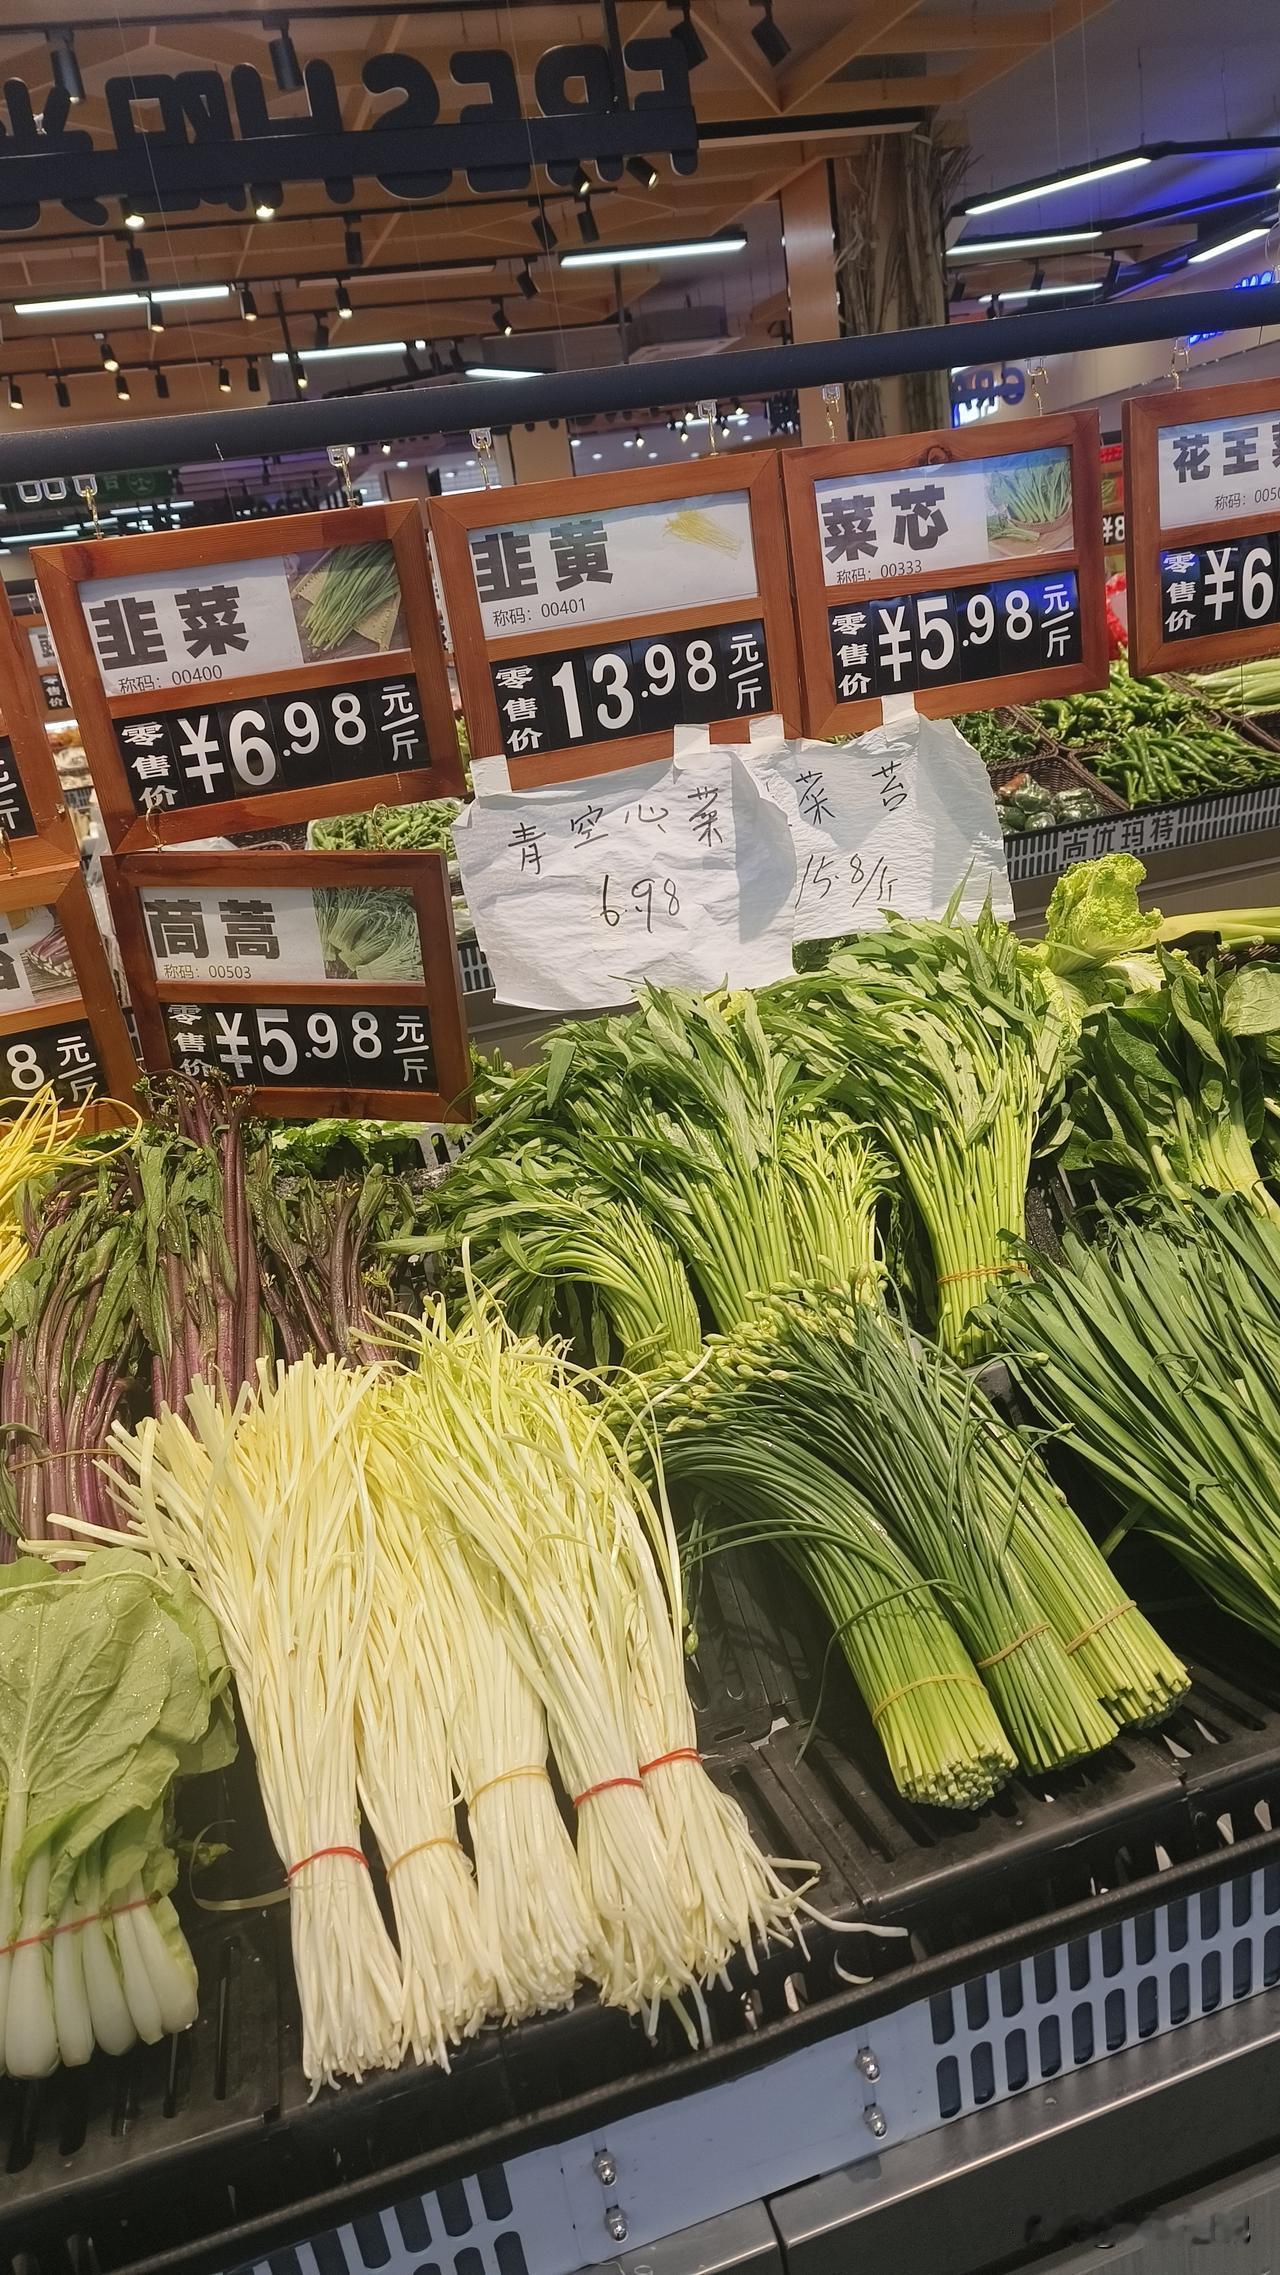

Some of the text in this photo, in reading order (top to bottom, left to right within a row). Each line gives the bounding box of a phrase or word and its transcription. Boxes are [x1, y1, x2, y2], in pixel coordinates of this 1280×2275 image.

[1173, 422, 1280, 483] 花王
[471, 519, 613, 602] 韭黄
[821, 484, 948, 563] 菜芯
[89, 585, 249, 670] 韭菜
[492, 598, 586, 627] 称码：00401
[1163, 547, 1273, 632] 零售价 ¥6
[832, 584, 1074, 696] 零售价 ¥5.98 元/斤
[118, 665, 222, 694] 称码：00400
[496, 634, 763, 752] 零售价 13.98 元/斤
[121, 684, 419, 808] 零售价 ¥6.98 元/斤
[766, 761, 907, 825] 菜苔
[1063, 814, 1174, 861] 尚优玛特
[144, 899, 280, 959] 茼蒿
[164, 965, 251, 979] 称码：00503
[168, 1005, 429, 1083] 零售价 ¥5.98 元/斤
